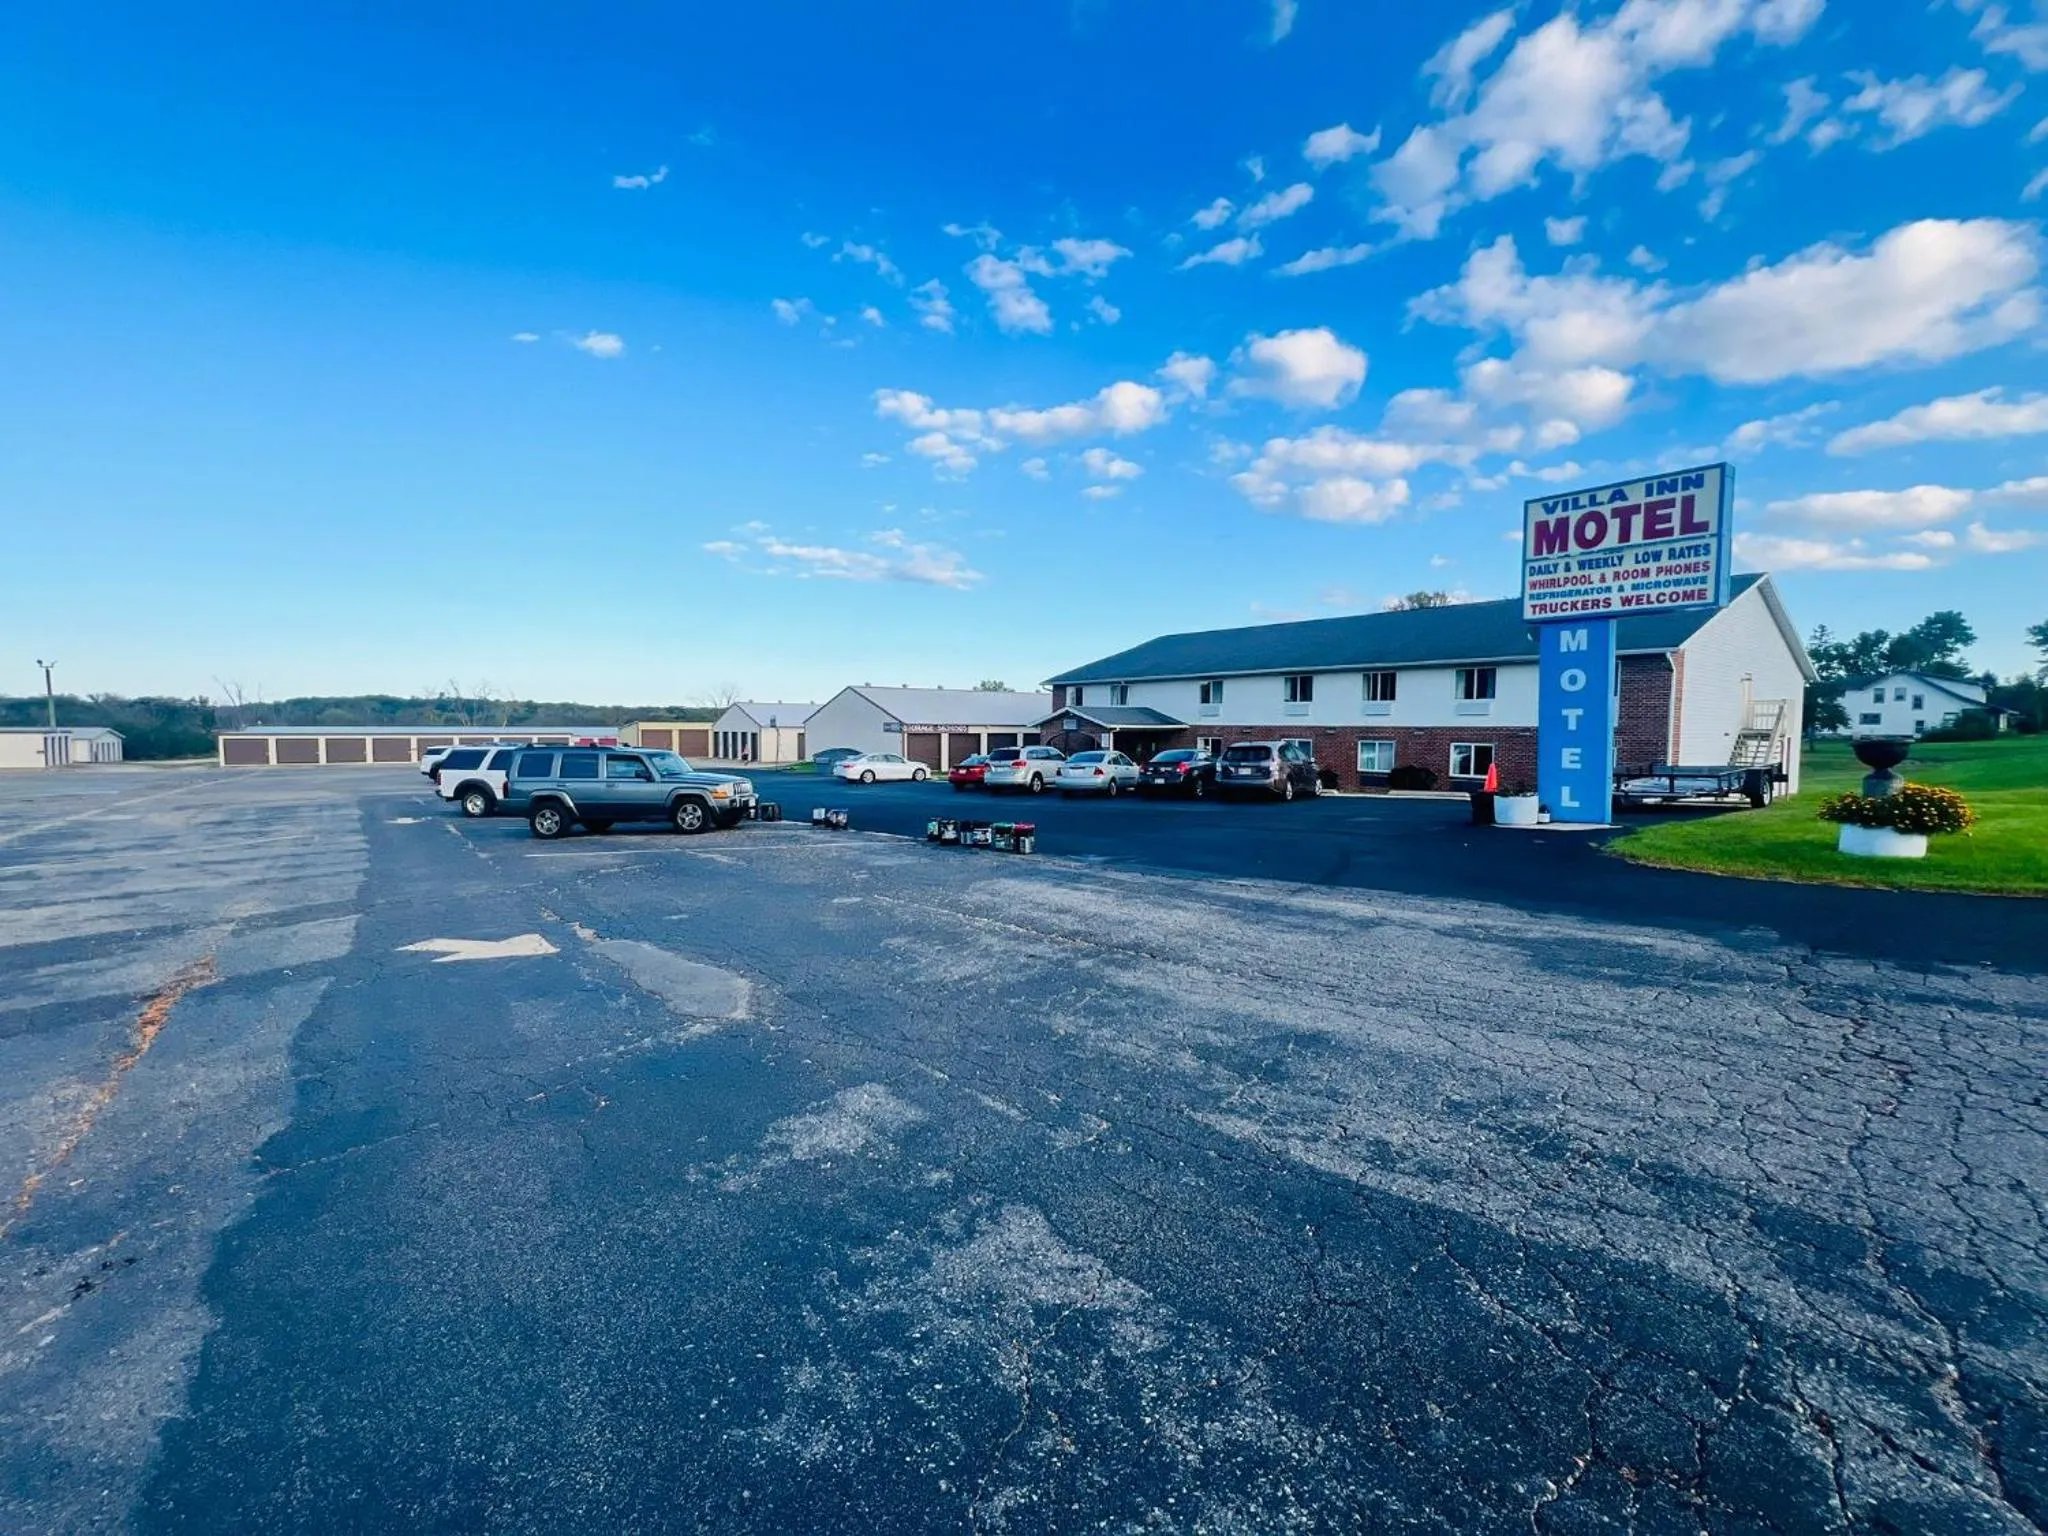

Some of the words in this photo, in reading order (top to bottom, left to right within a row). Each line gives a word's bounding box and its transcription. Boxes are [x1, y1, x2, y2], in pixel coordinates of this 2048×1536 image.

[1541, 487, 1630, 515] VILLA
[1645, 472, 1705, 498] INN
[1532, 494, 1710, 557] MOTEL
[1528, 562, 1559, 577] DAILY
[1577, 554, 1624, 571] WEEKLY
[1634, 549, 1663, 565] LOW
[1668, 543, 1711, 561] RATES
[1528, 573, 1594, 591] WHIRLPOOL
[1612, 567, 1650, 582] ROOM
[1655, 560, 1711, 577] PHONES
[1528, 586, 1612, 601] REFRIGERATOR
[1631, 575, 1708, 592] MICROWAVE
[1530, 597, 1612, 616] TRUCKERS
[1620, 588, 1708, 607] WELCOME
[1559, 628, 1588, 808] MOTEL
